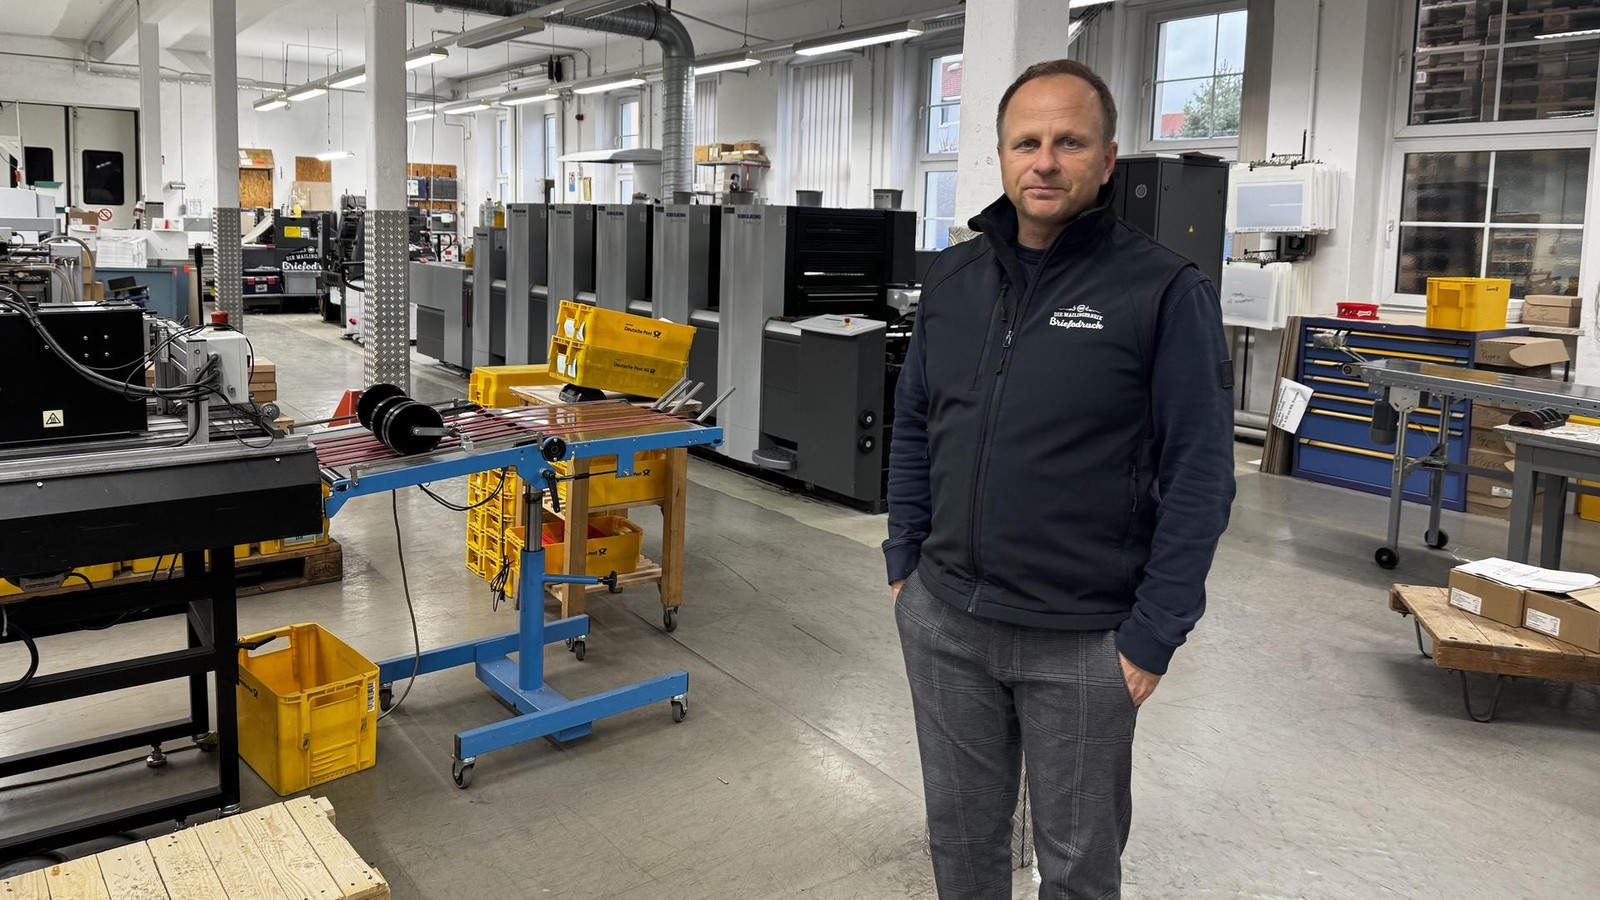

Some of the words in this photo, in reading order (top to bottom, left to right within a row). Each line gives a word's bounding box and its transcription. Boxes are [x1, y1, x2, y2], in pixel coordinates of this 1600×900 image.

[1049, 317, 1104, 329] Briefodruck
[624, 326, 642, 334] Deutsche
[613, 362, 633, 370] Deutsche
